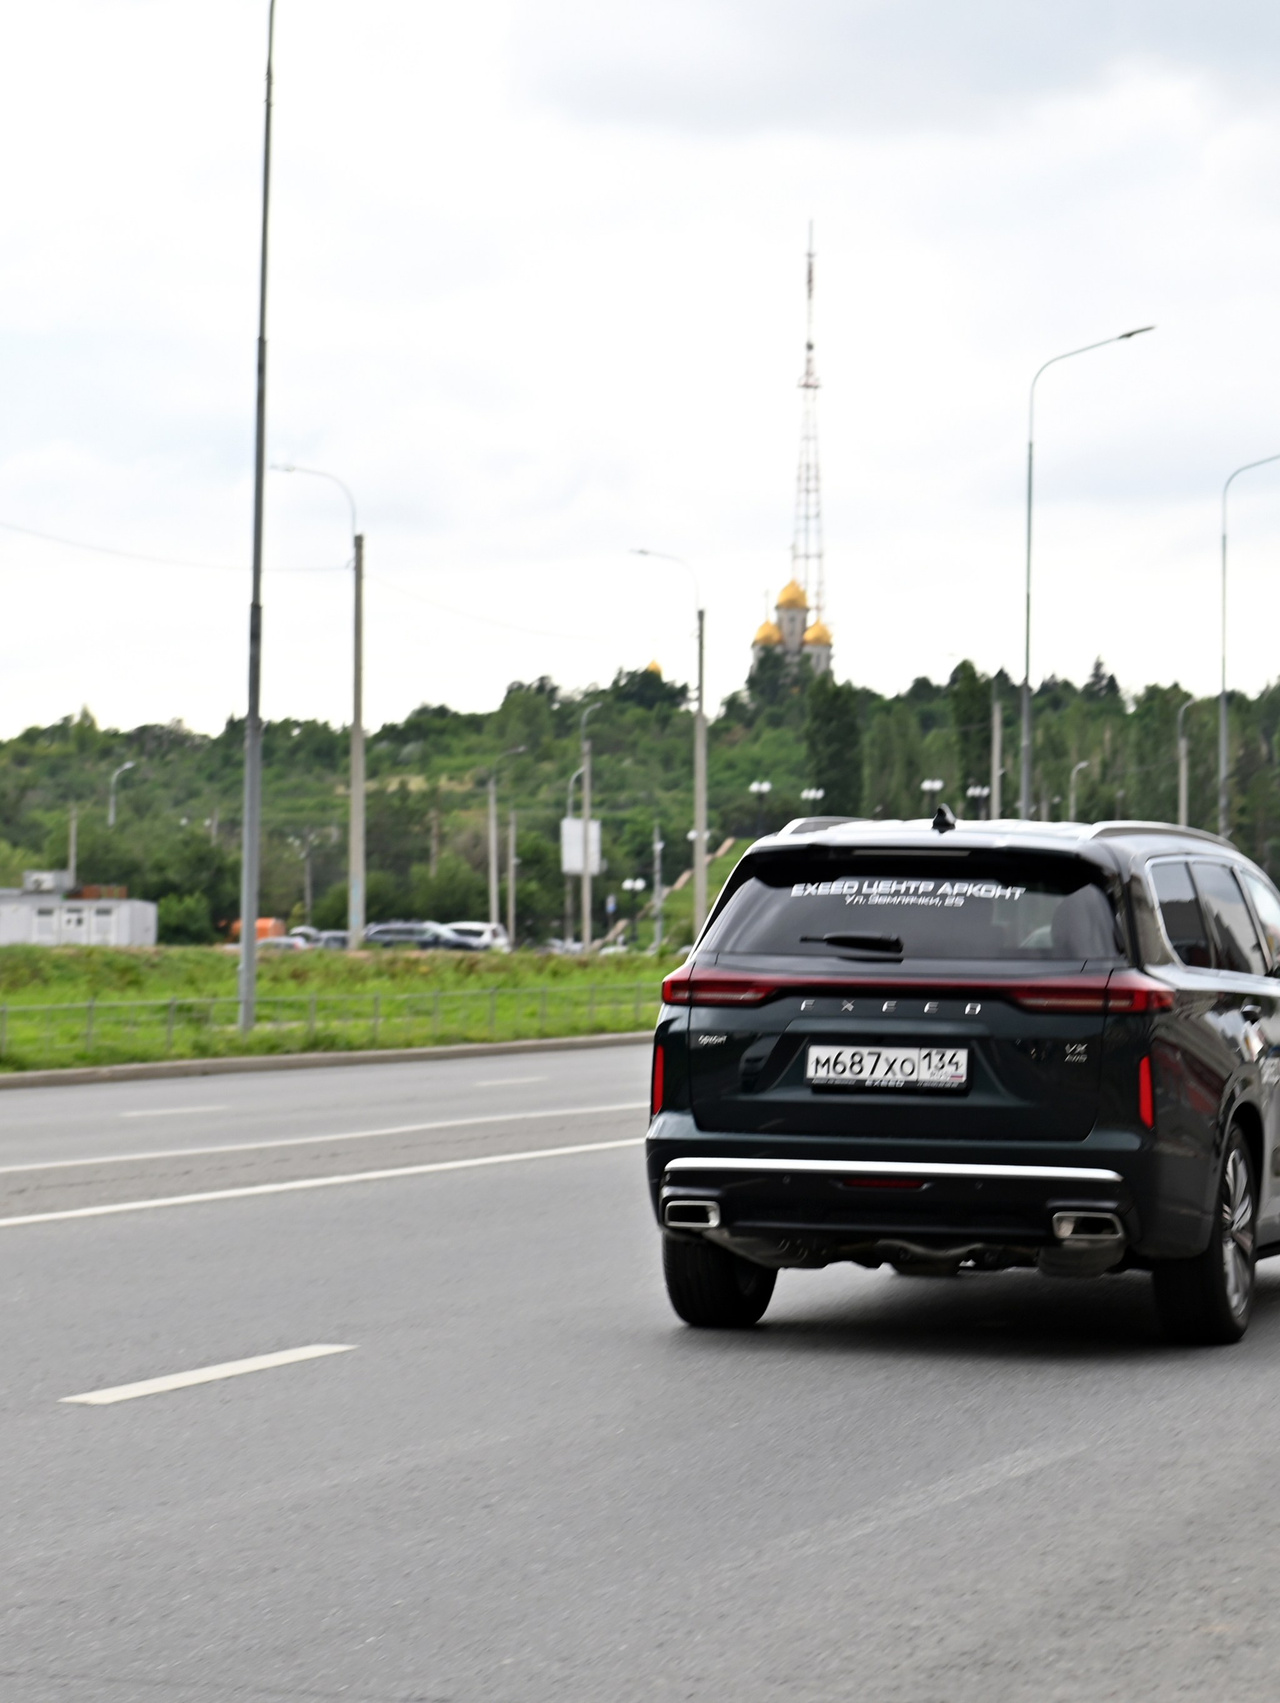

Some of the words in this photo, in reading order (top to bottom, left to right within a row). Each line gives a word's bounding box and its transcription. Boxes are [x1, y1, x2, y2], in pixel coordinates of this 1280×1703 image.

[791, 880, 859, 897] EXEED
[862, 880, 935, 895] ЦЕНТР
[937, 882, 1027, 900] АРКОНТ
[800, 1000, 982, 1015] EXEED
[921, 1049, 963, 1072] 134
